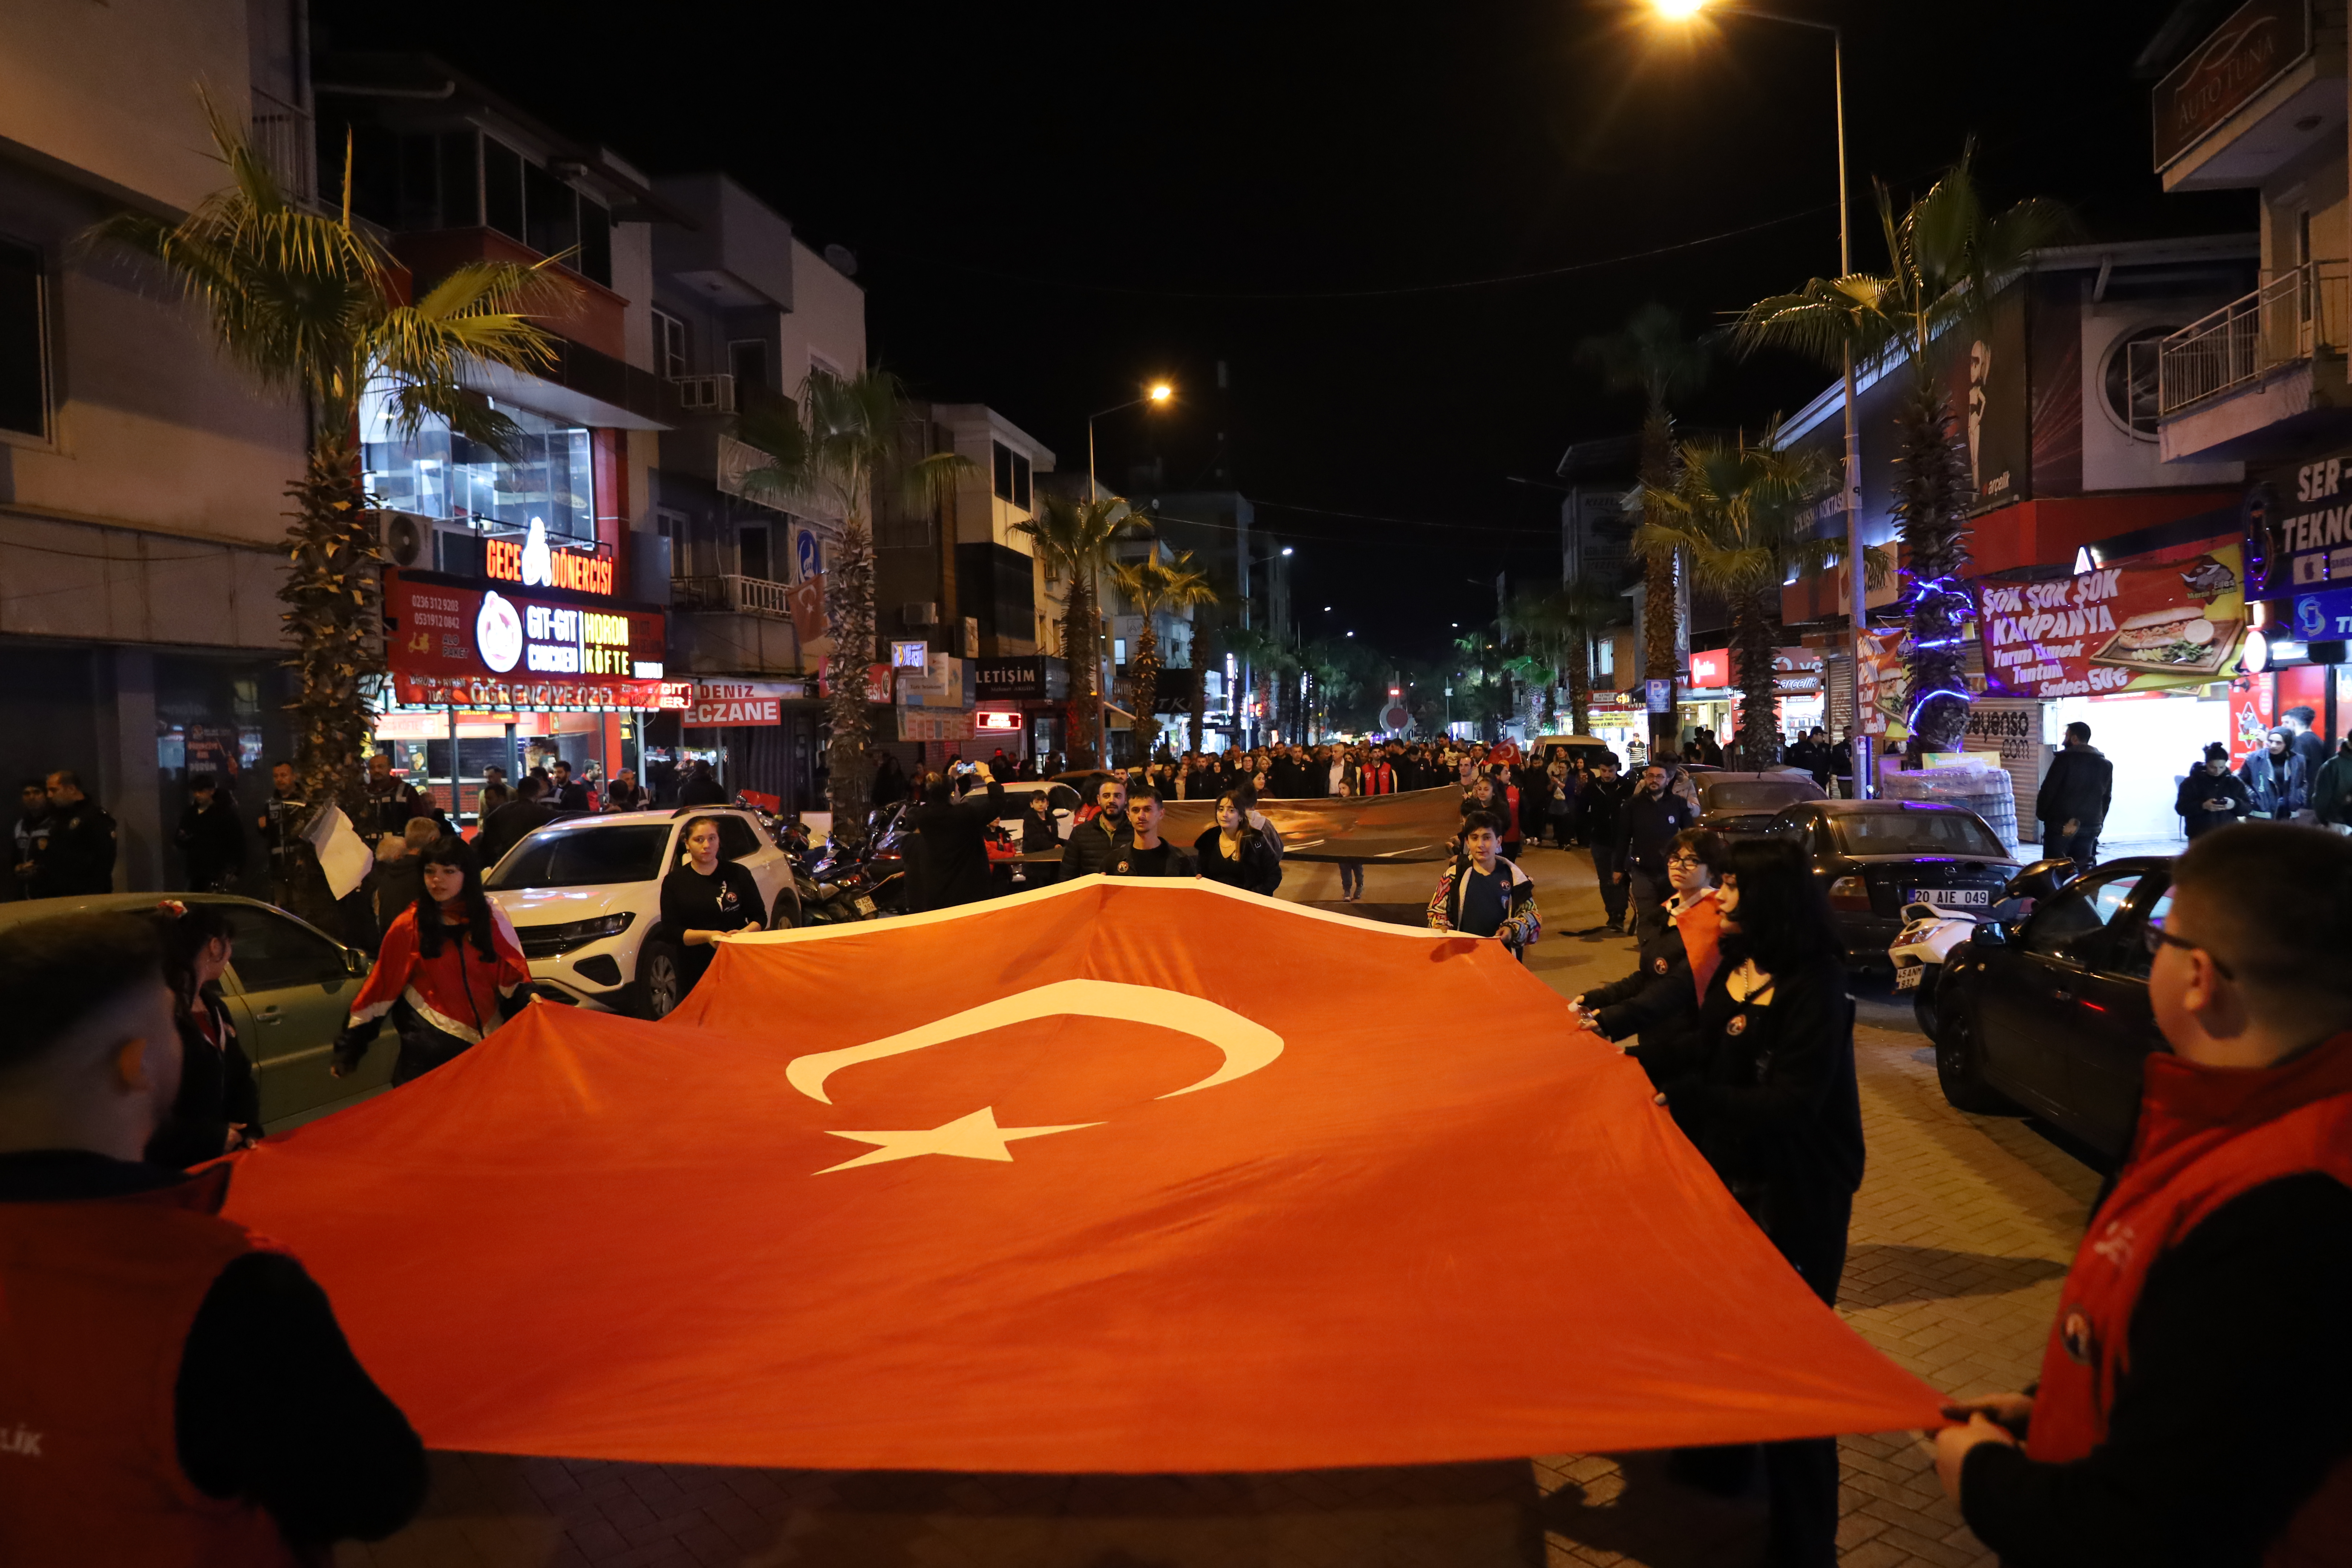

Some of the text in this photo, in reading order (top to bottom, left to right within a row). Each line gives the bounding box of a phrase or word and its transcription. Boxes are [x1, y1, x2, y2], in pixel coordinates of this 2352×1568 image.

[2179, 33, 2274, 130] AUTO TUNA
[1988, 470, 2010, 496] arçelik
[2297, 458, 2340, 502] SER
[487, 539, 613, 595] GECE DÖNERCİSİ
[412, 594, 429, 608] 0236
[430, 597, 443, 610] 312
[1983, 568, 2122, 622] ŞOK ŞOK ŞOK
[584, 612, 629, 646] HORON
[1993, 605, 2116, 647] KAMPANYA
[443, 634, 459, 646] ALO
[443, 646, 469, 659] PAKET
[585, 646, 630, 675] KÖFTE
[1993, 640, 2086, 668] Yarım Ekmek
[975, 666, 1035, 685] LETİŞİM
[2012, 660, 2064, 684] Tantuni
[471, 677, 574, 706] ÖĞRENCİYE
[576, 681, 617, 706] ÖZEL
[1651, 681, 1663, 695] P
[1781, 677, 1818, 691] arçelik
[2038, 678, 2090, 698] Sadece
[684, 701, 778, 723] ECZANE
[1916, 891, 1987, 903] 20 AIE 049
[1898, 969, 1906, 978] 45
[1901, 977, 1914, 988] 932
